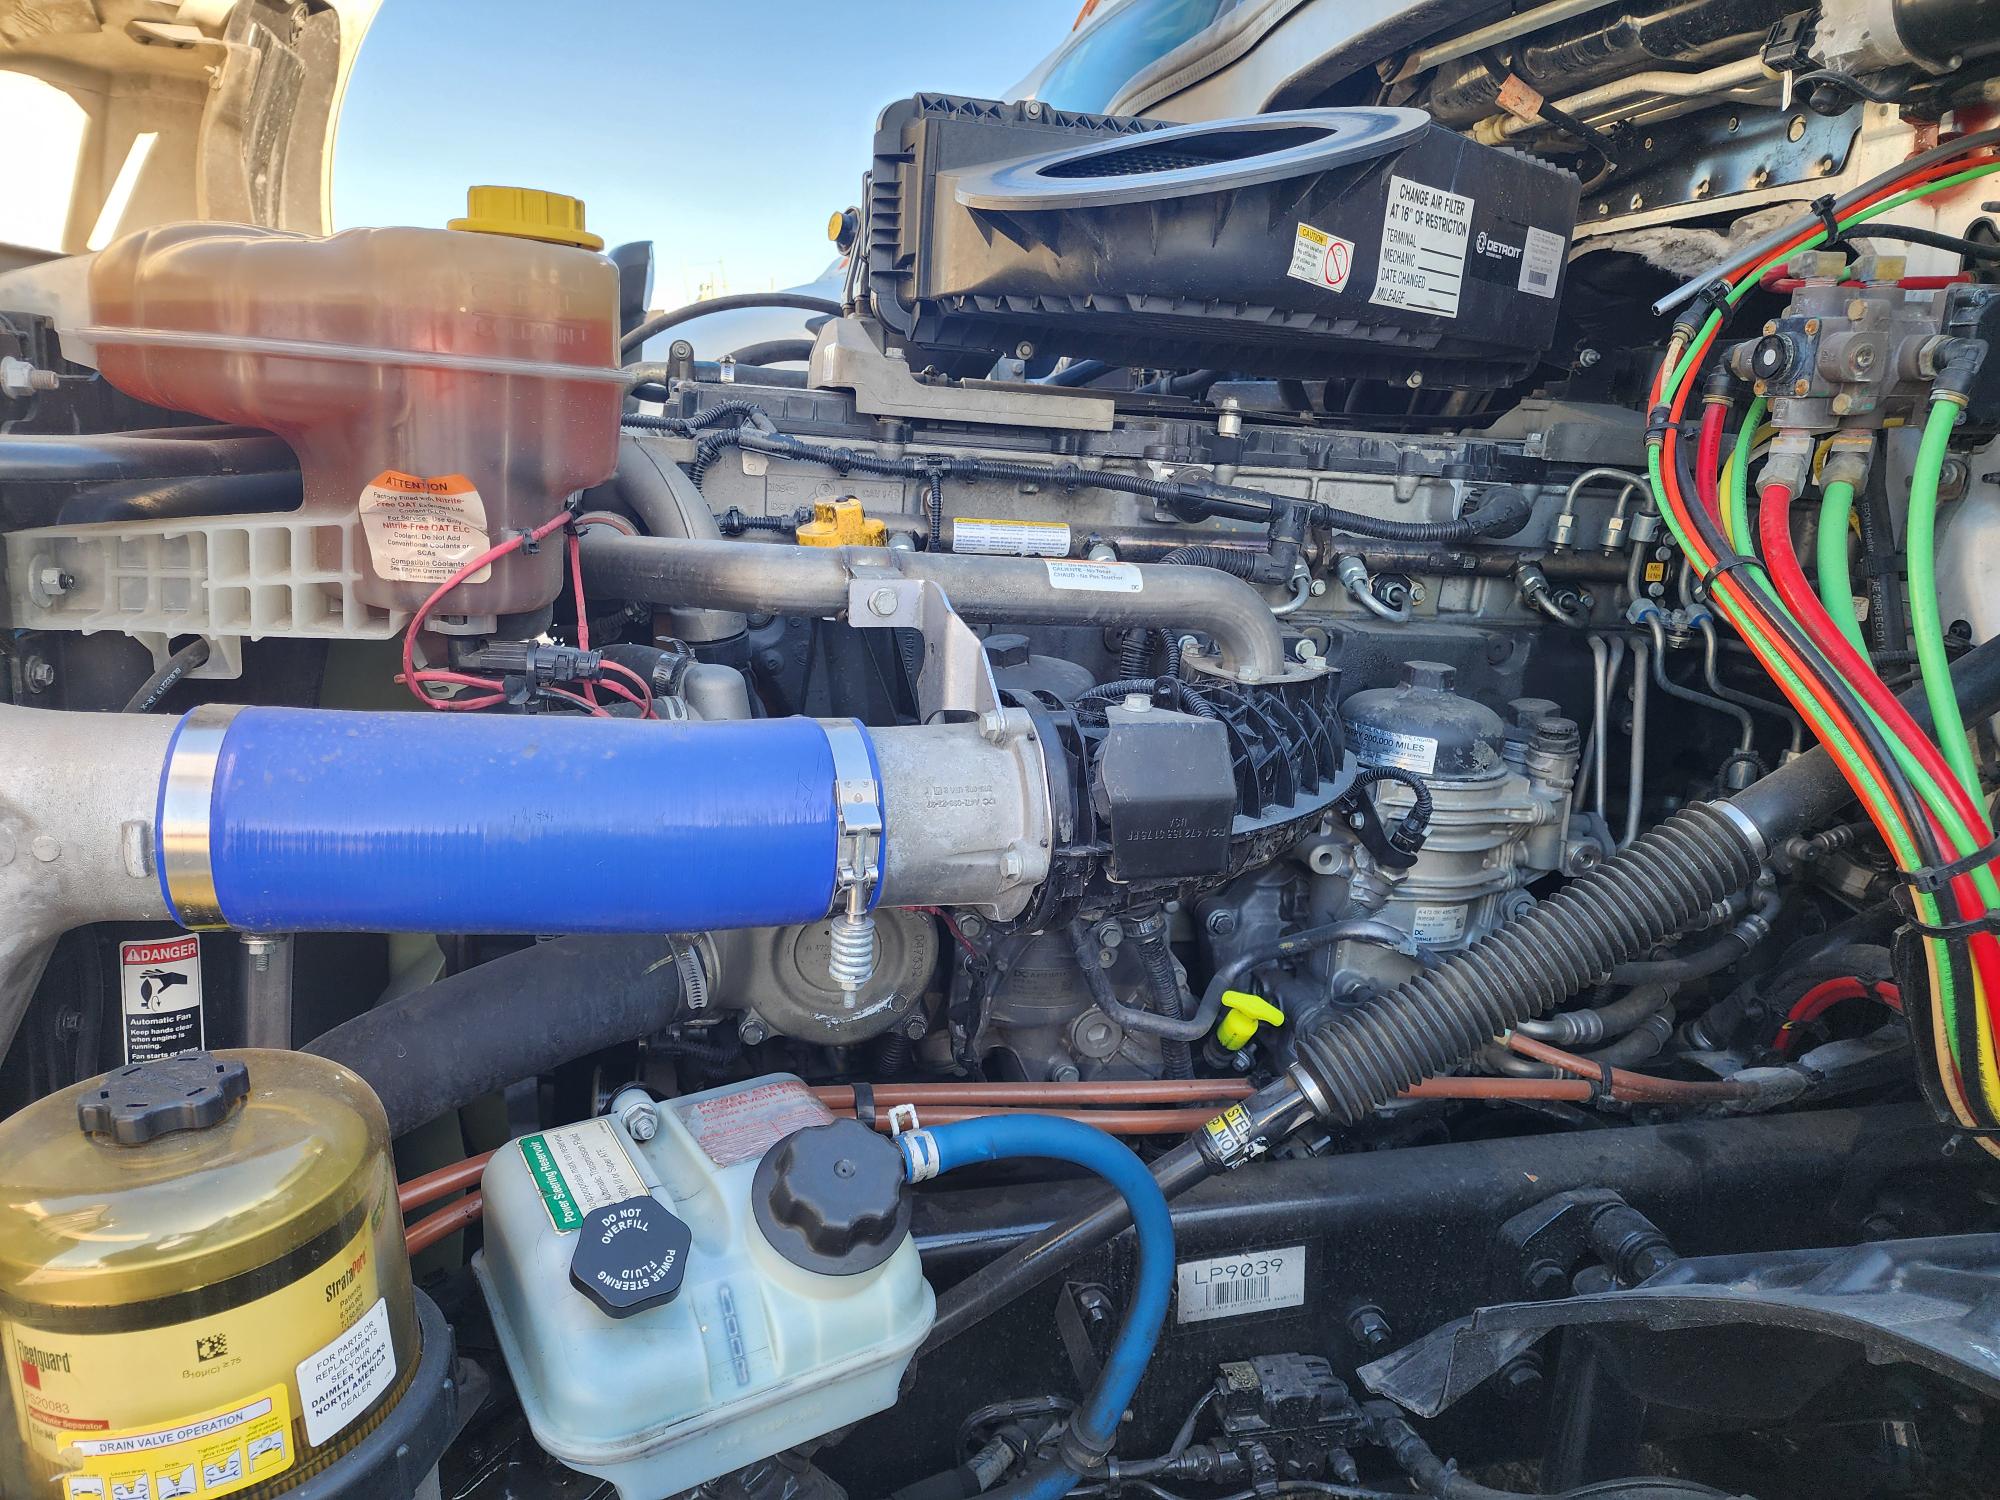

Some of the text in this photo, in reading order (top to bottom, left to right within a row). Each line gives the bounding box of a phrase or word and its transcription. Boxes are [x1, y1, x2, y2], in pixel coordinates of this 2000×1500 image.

[1400, 184, 1465, 216] CHANGE AIR FILTER
[1390, 203, 1399, 218] AT
[1415, 210, 1424, 225] OF
[1426, 213, 1467, 237] RESTRICTION
[1303, 229, 1323, 243] CAUTION
[1387, 228, 1416, 248] TERMINAL
[1384, 248, 1415, 267] MECHANIC
[1487, 240, 1522, 258] DETROIT
[1381, 268, 1425, 288] DATE CHANGED
[1375, 287, 1405, 303] MILEAGE
[386, 477, 447, 490] ATTENTION
[374, 492, 397, 501] Factory
[383, 523, 429, 531] Nitrite-Free
[388, 539, 428, 547] Conventional
[391, 557, 430, 566] Compatible
[1364, 733, 1393, 747] 200,000
[1396, 741, 1425, 752] MILES
[141, 942, 196, 961] DANGER
[130, 1013, 192, 1025] Automatic Fan
[130, 1028, 149, 1036] Keep
[175, 1024, 193, 1032] clear
[152, 1034, 177, 1042] engine
[1214, 1131, 1235, 1151] NO
[531, 1141, 577, 1223] Power Steering Reservoir
[601, 1208, 641, 1227] DO NOT
[601, 1219, 649, 1244] OVERFILL
[597, 1249, 676, 1291] POWER STEERING
[621, 1260, 658, 1279] FLUID
[1195, 1258, 1284, 1285] LP9039
[316, 1320, 374, 1370] FOR PARTS OR
[17, 1339, 71, 1373] Fleetguard
[316, 1328, 377, 1383] REPLACEMENTS
[331, 1347, 370, 1383] SEE YOUR
[311, 1342, 386, 1408] DAIMLER TRUCKS
[315, 1355, 386, 1417] NORTH AMERICA
[341, 1380, 372, 1410] DEALER
[62, 1420, 103, 1430] Separator
[100, 1442, 134, 1452] DRAIN
[137, 1433, 174, 1448] VALVE
[177, 1411, 243, 1440] OPERATION
